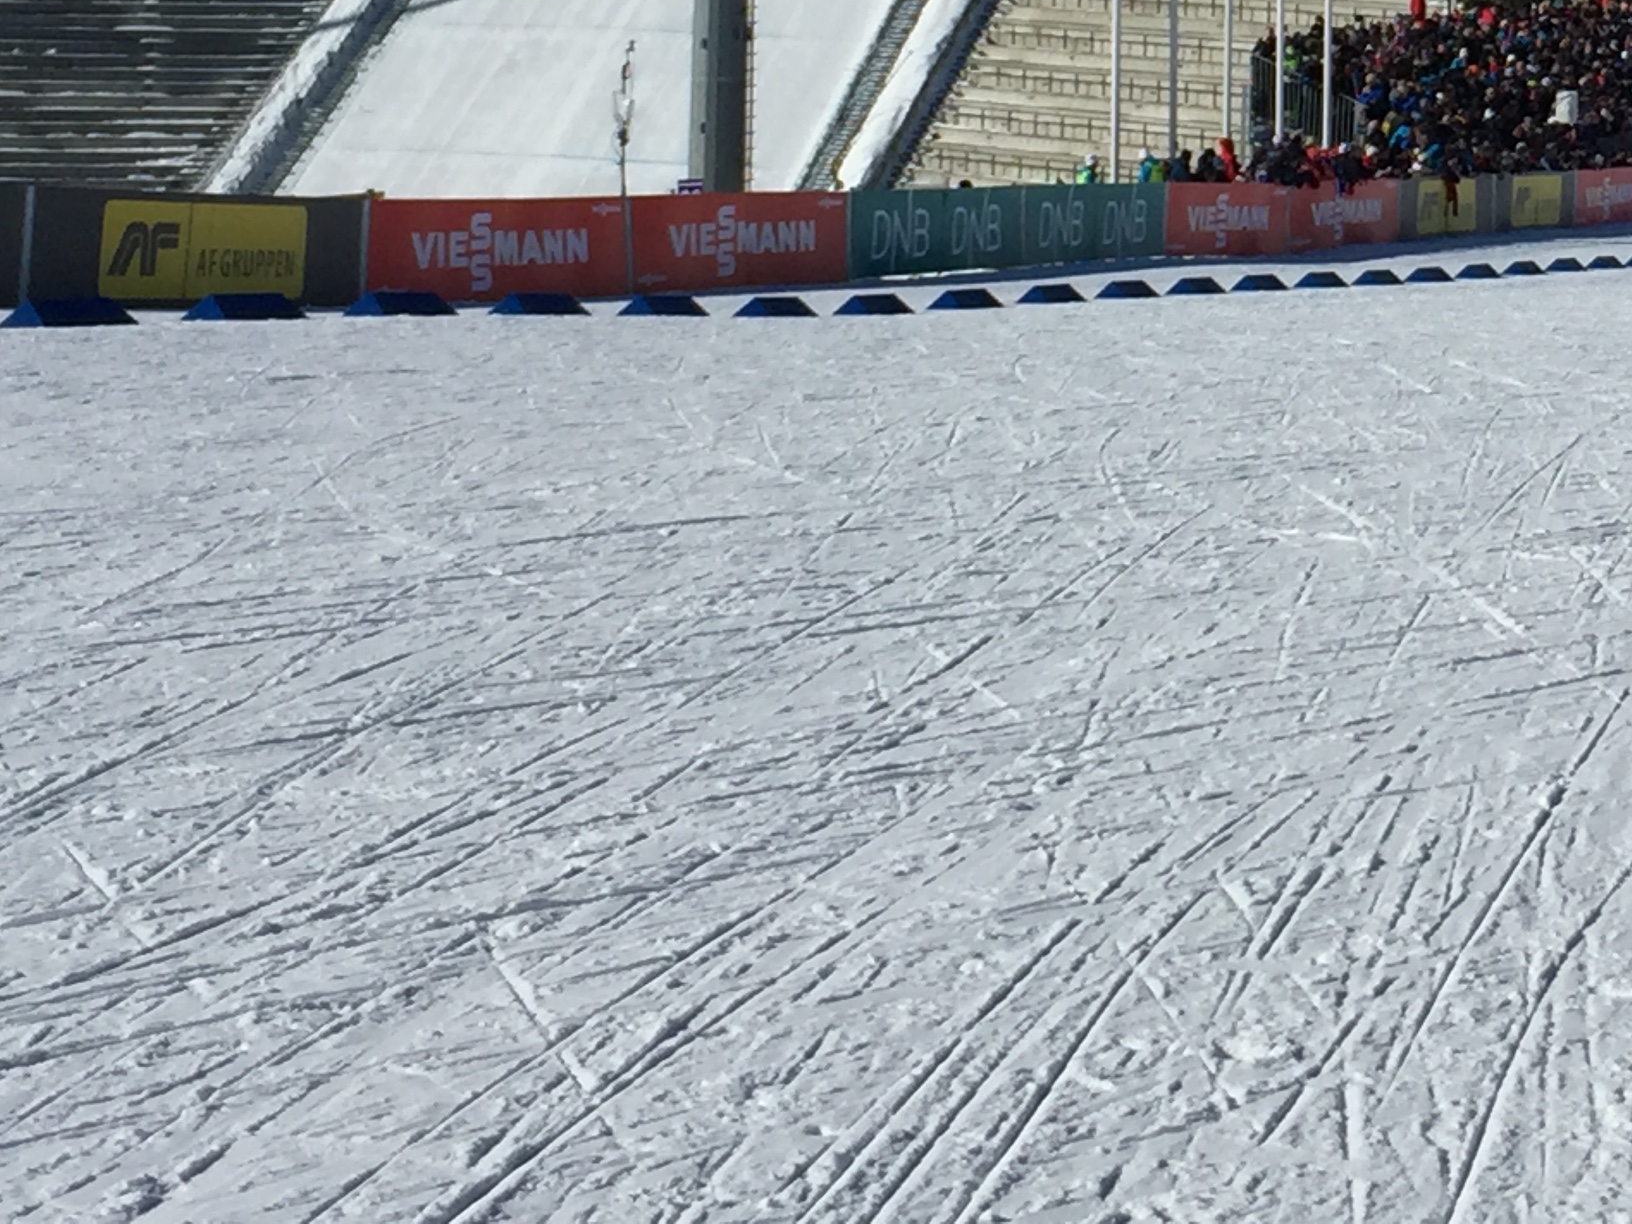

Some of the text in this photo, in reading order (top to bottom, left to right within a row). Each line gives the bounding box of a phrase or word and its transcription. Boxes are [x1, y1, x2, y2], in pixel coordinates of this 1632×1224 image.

[411, 213, 589, 291] VIESSMANN
[669, 205, 816, 276] VIESSMANN
[871, 190, 930, 268] DNB
[951, 192, 1001, 263] DNB
[1038, 185, 1094, 254] DNB
[1102, 186, 1147, 252] DNB
